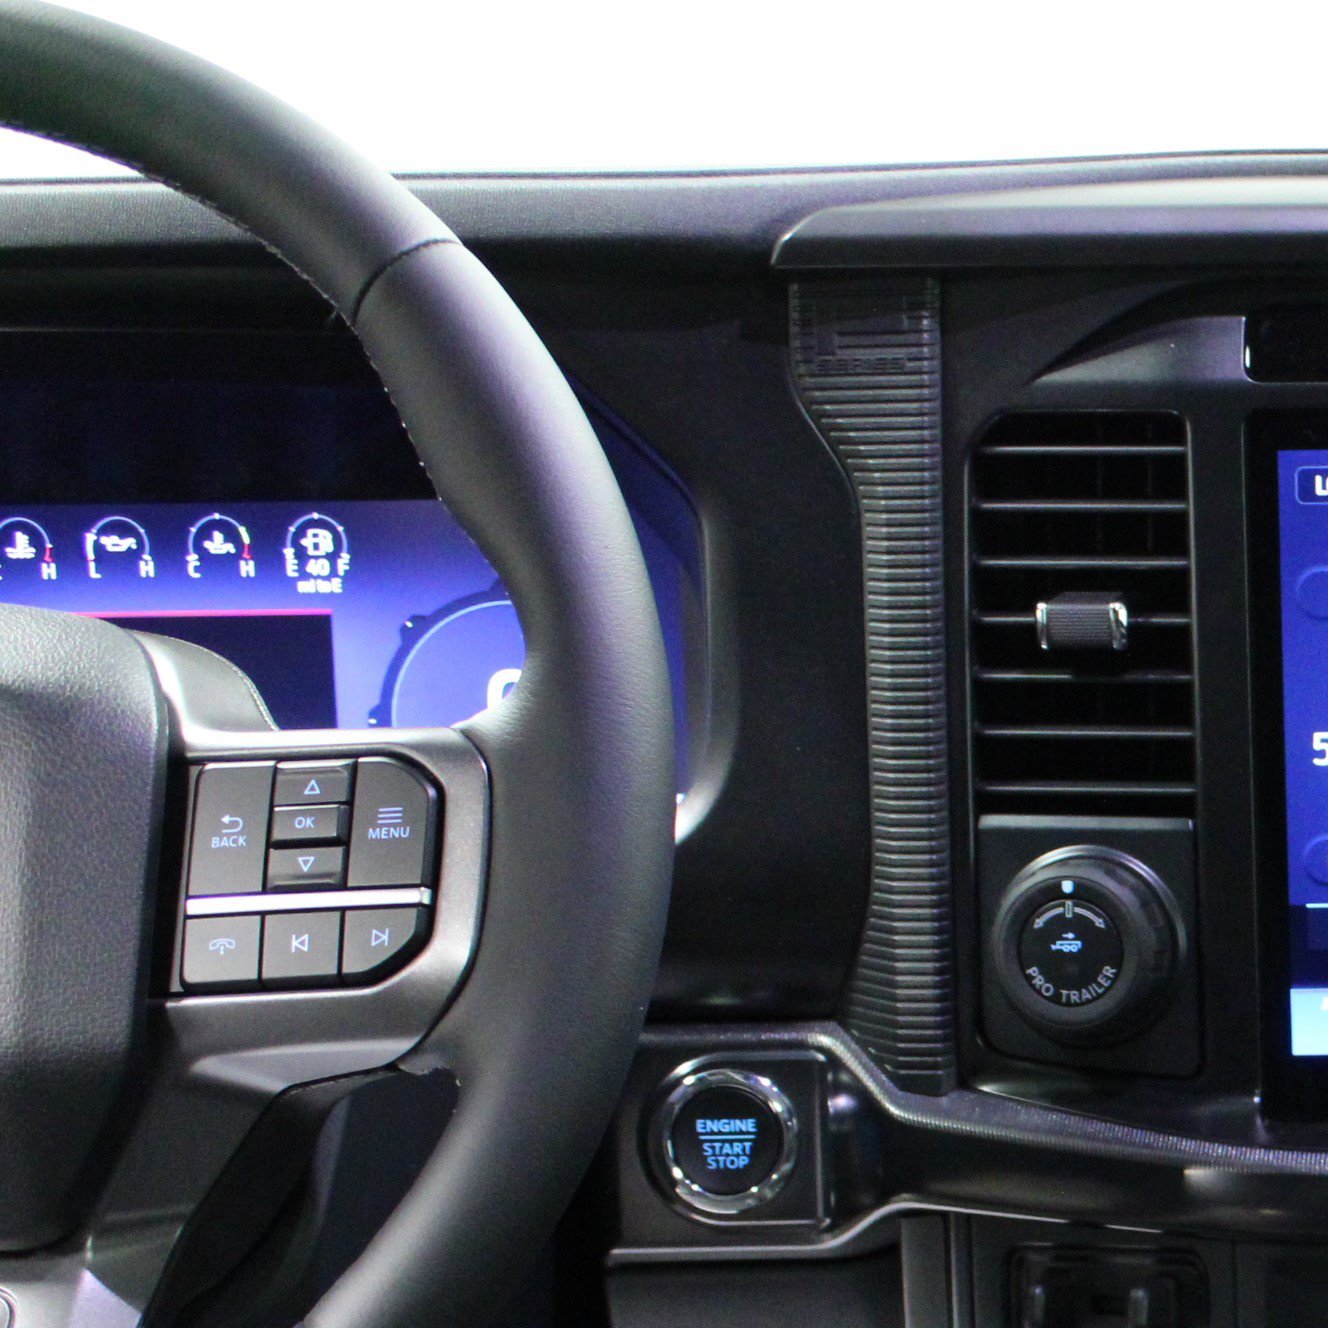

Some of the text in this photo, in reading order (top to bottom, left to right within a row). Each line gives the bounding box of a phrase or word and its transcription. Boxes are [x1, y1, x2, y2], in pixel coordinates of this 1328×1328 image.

[40, 559, 57, 580] H
[138, 560, 156, 578] H
[238, 557, 255, 578] H
[305, 558, 331, 577] 40
[294, 816, 316, 829] OK
[367, 826, 410, 840] MENU
[210, 835, 247, 849] BACK
[1025, 965, 1118, 1004] PRO TRAILER
[695, 1118, 758, 1134] ENGINE
[702, 1142, 753, 1156] START
[706, 1156, 750, 1170] STOP
